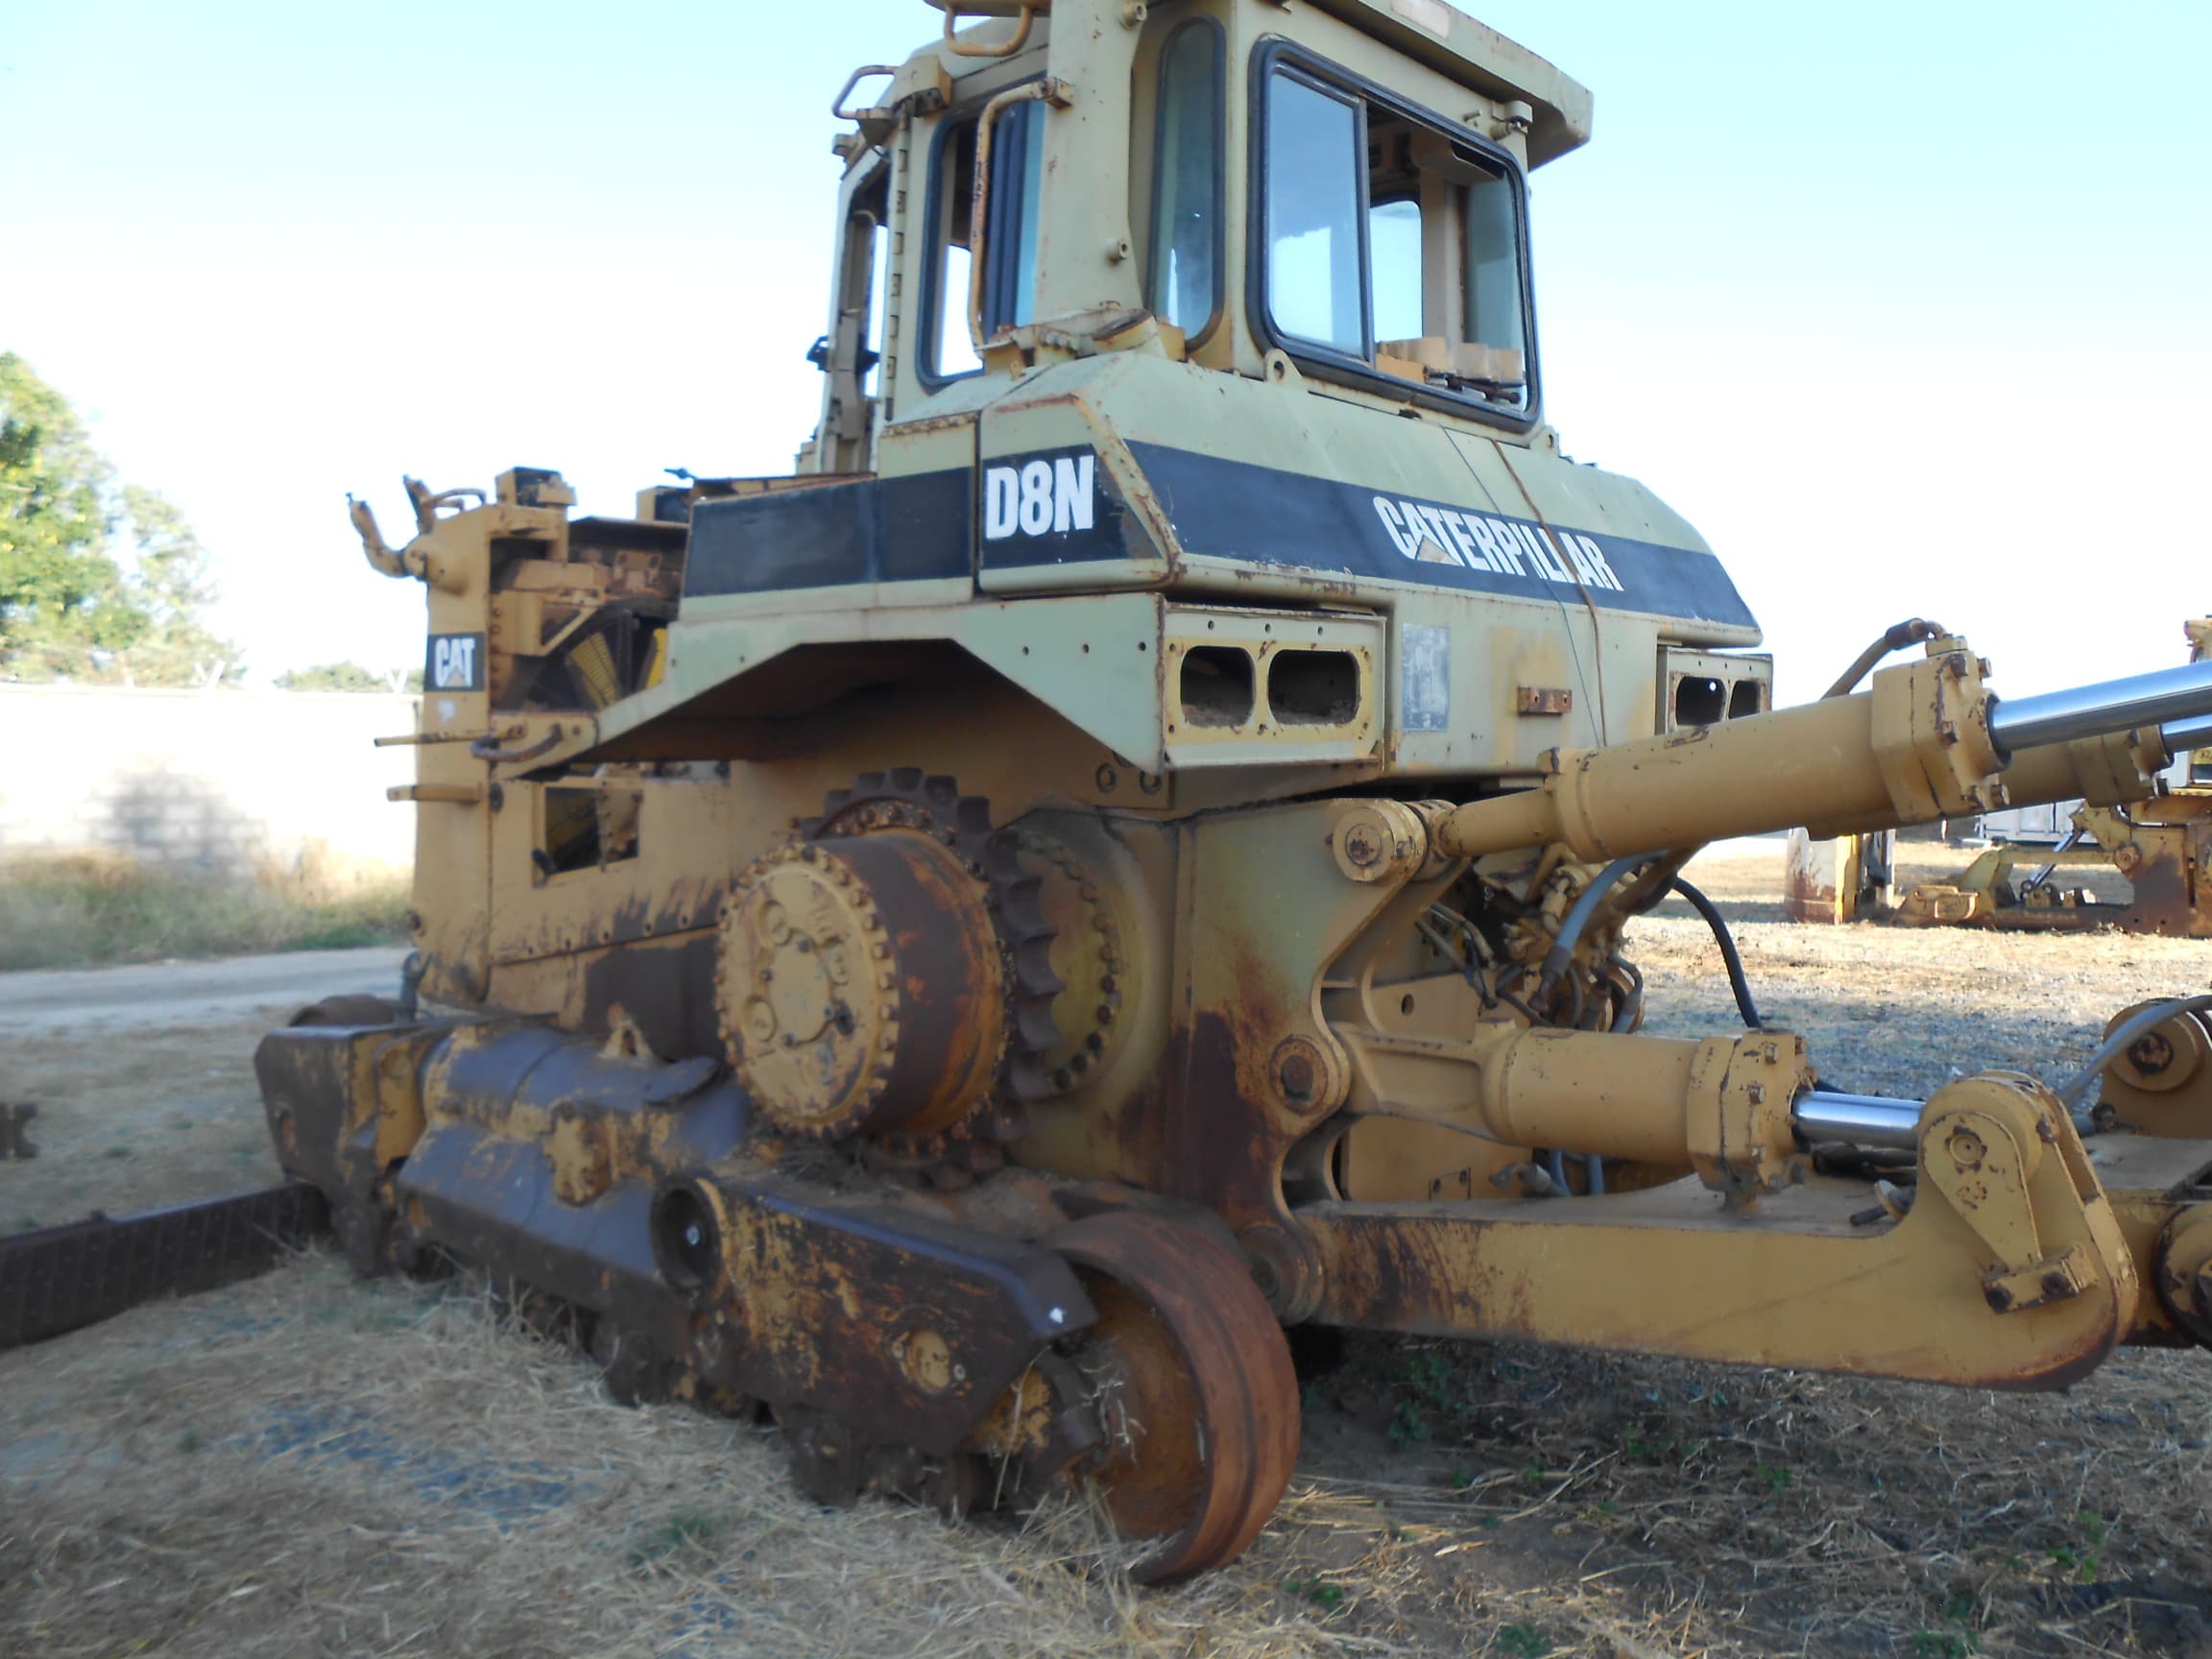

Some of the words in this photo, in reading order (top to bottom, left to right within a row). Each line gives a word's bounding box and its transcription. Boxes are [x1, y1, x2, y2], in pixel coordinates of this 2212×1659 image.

[986, 455, 1094, 540] D8N
[1373, 496, 1624, 591] CATERPILLAR
[435, 637, 475, 687] CAT
